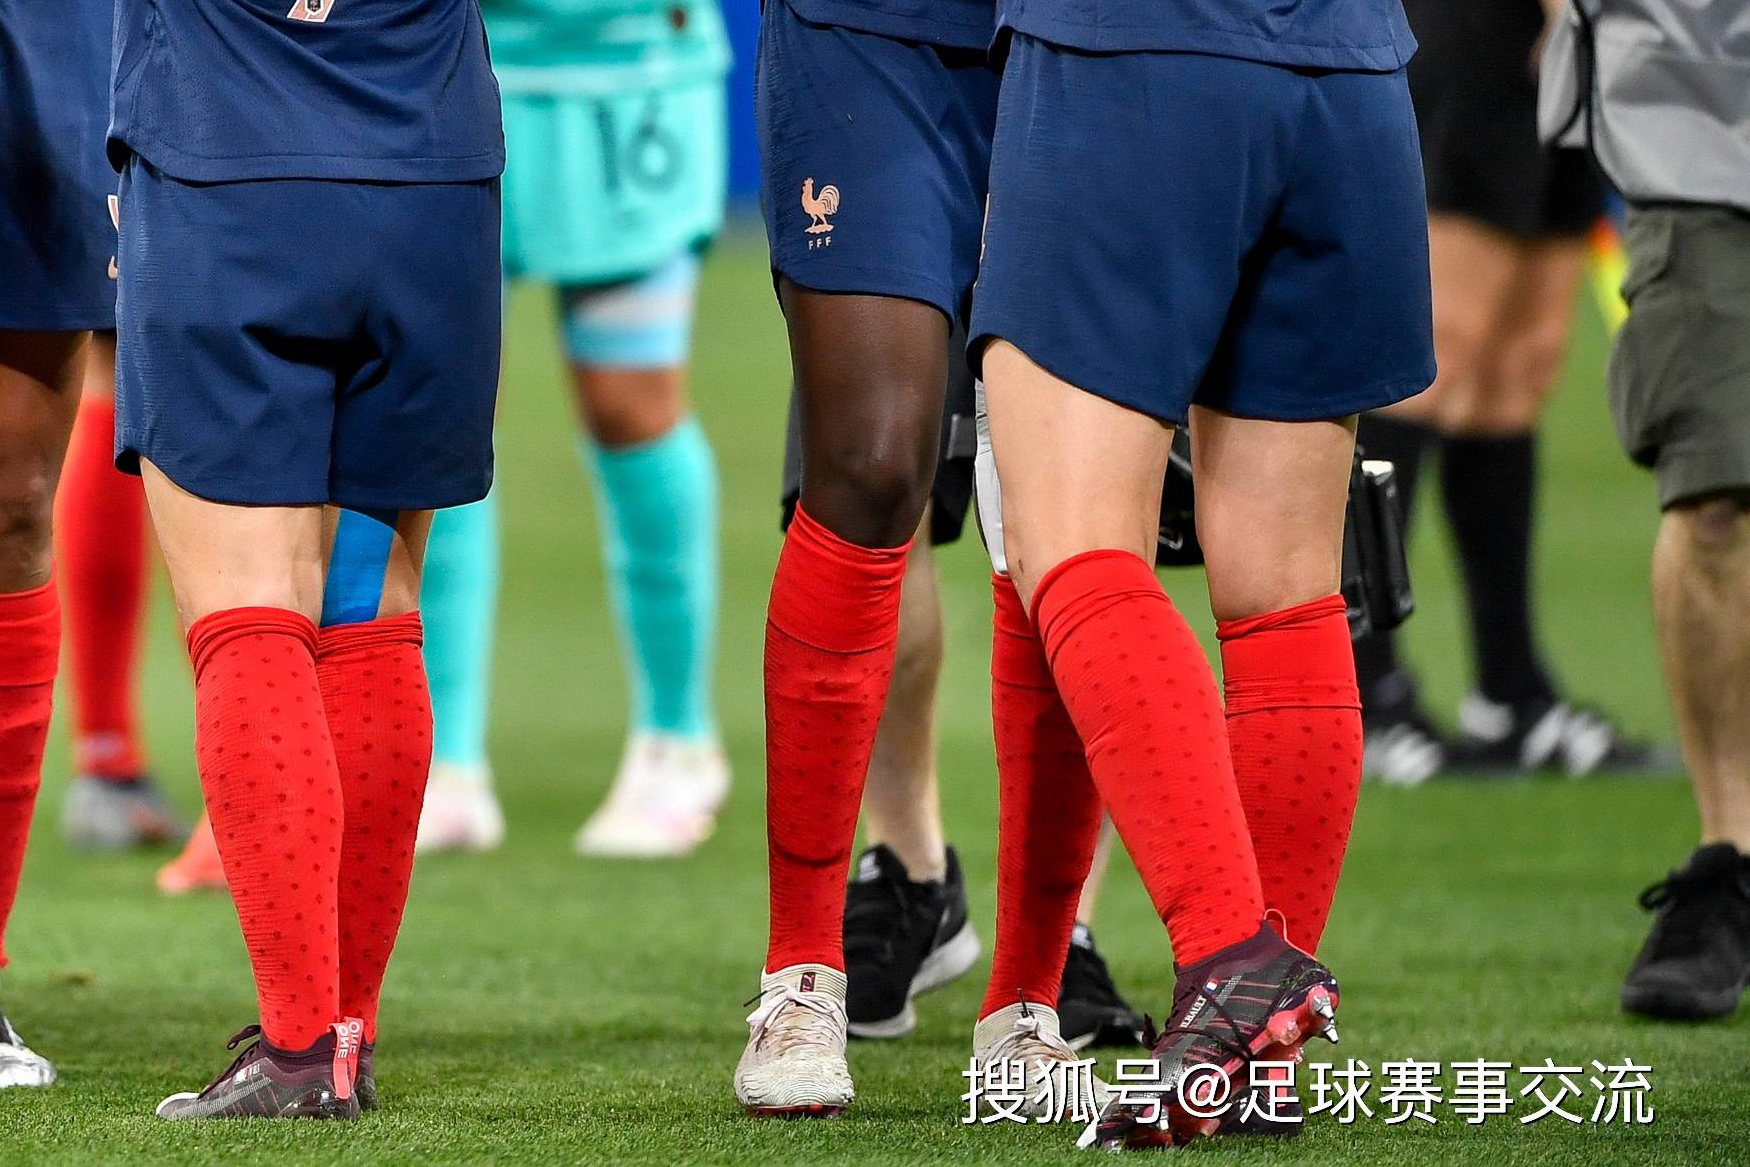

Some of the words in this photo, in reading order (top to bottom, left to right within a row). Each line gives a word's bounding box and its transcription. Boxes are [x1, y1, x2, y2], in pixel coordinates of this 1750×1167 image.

[589, 94, 682, 192] 16
[808, 236, 832, 251] FFF
[1179, 994, 1208, 1028] ILBAULT
